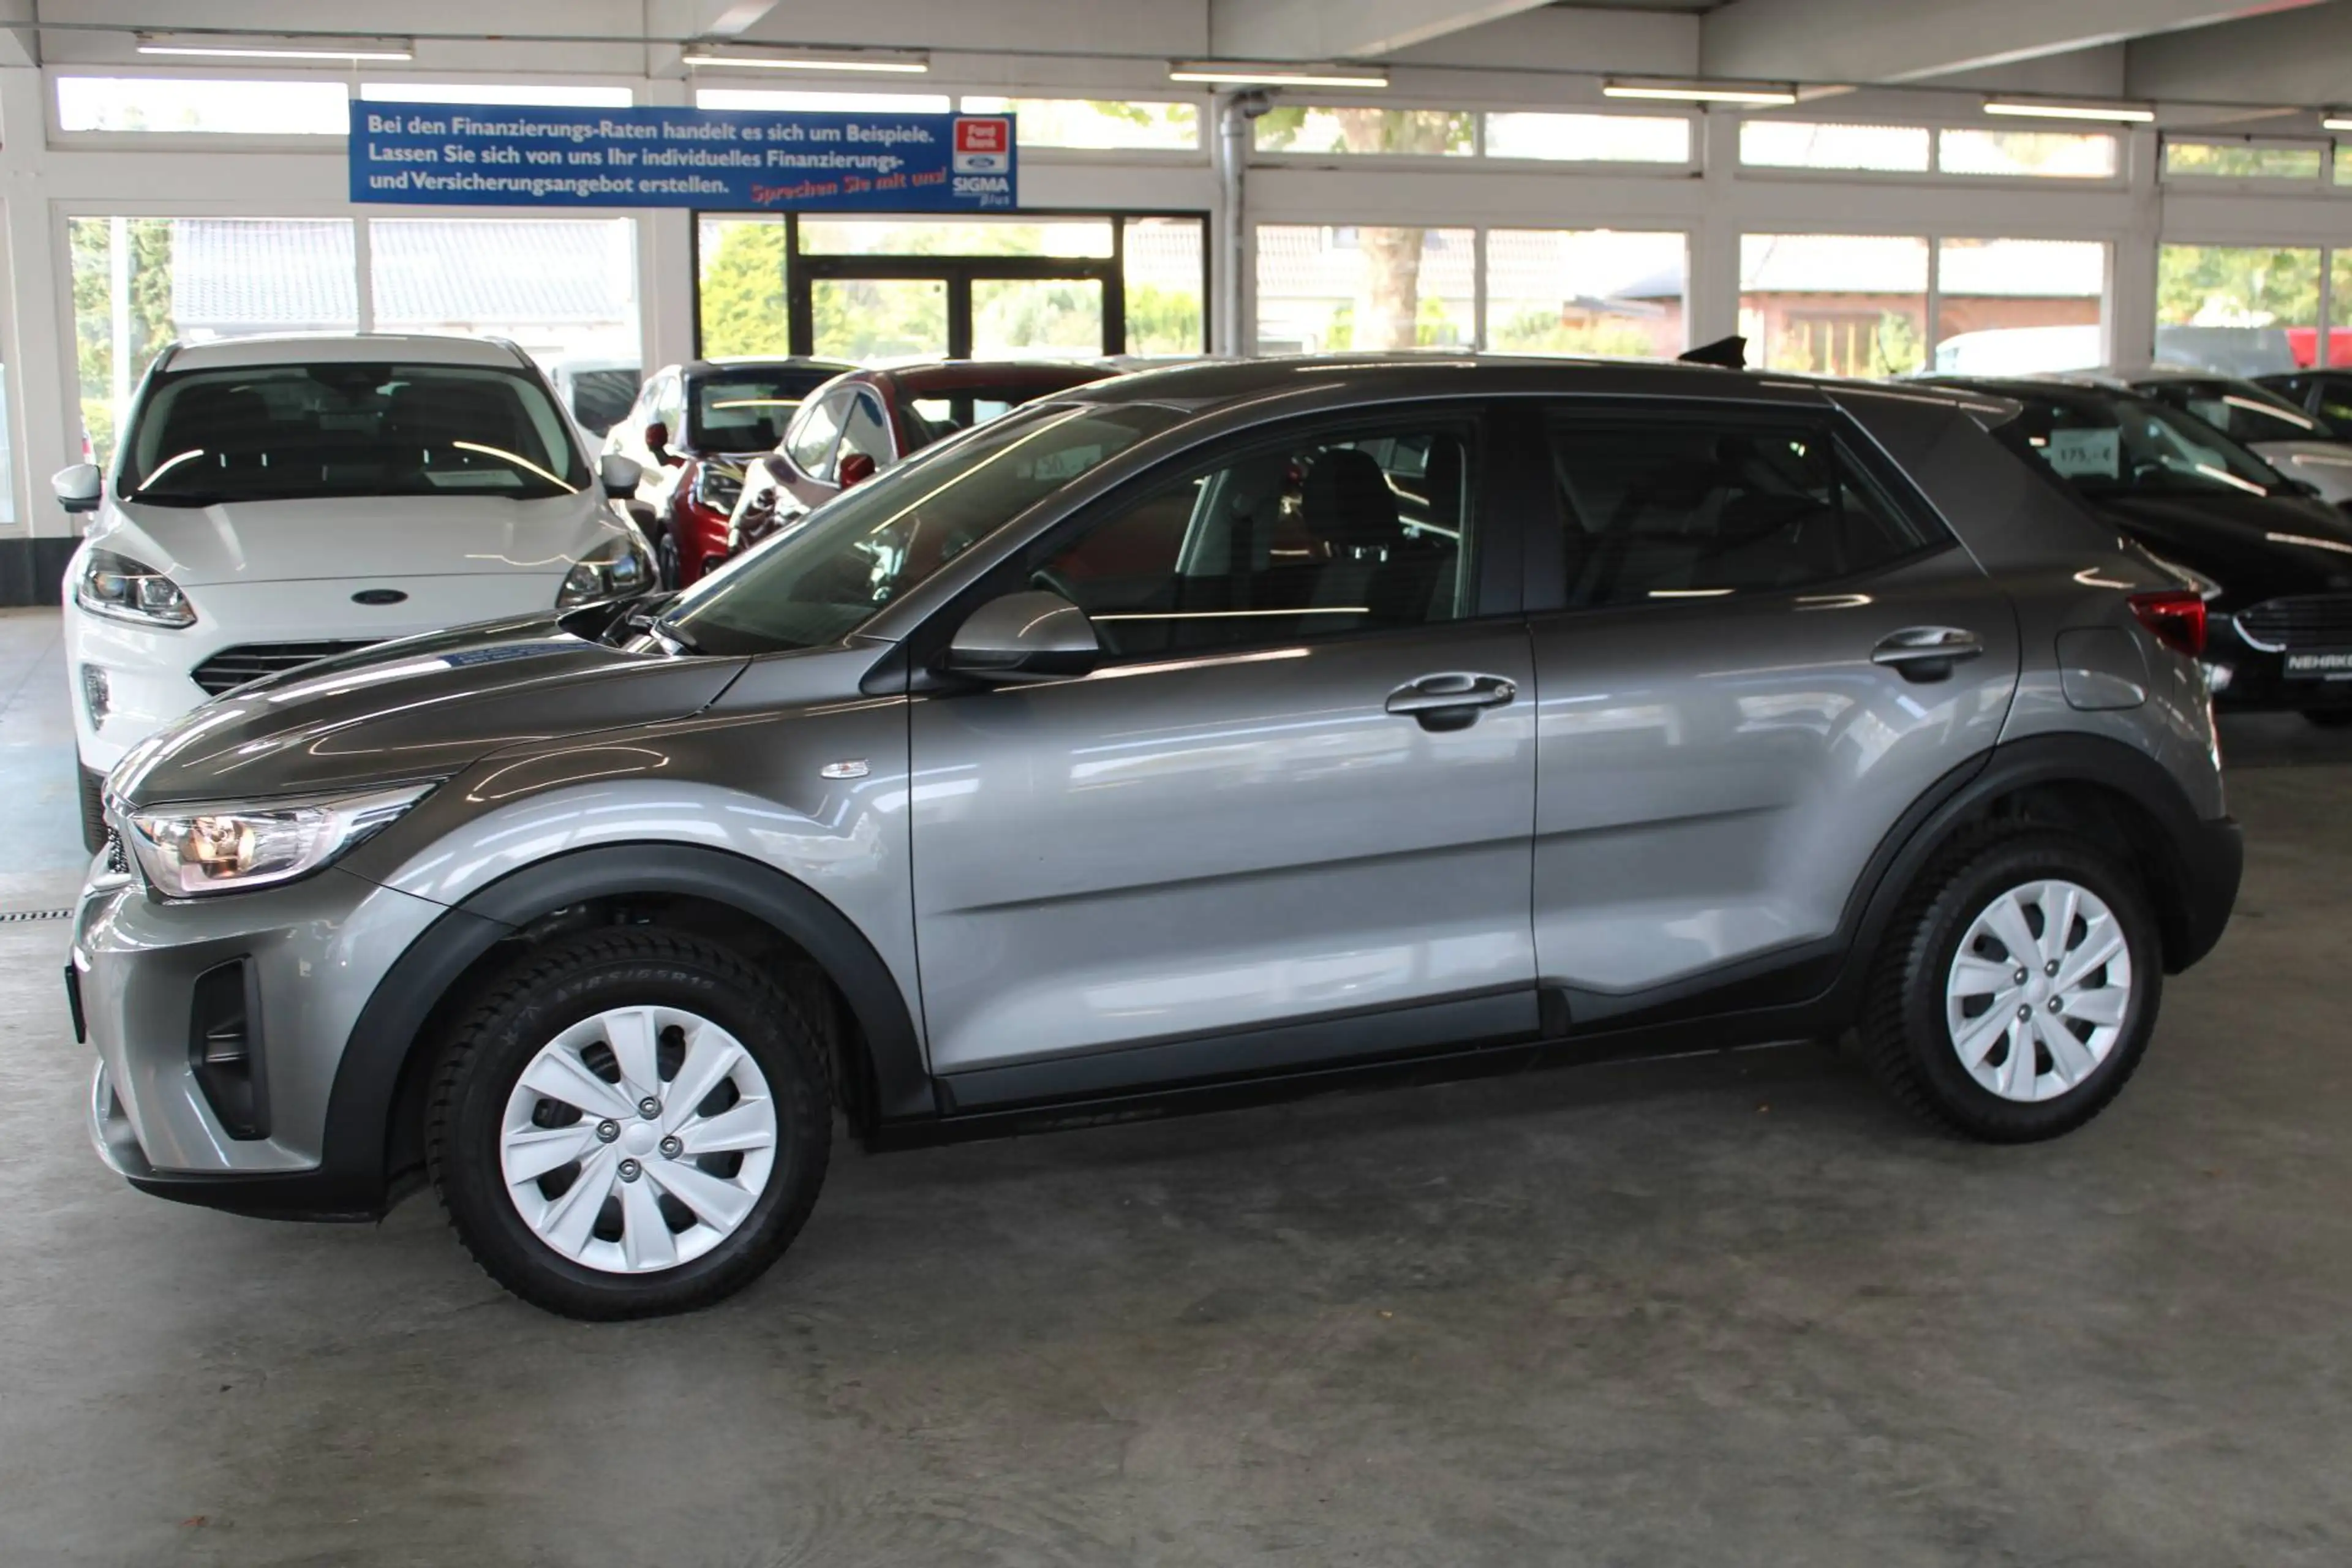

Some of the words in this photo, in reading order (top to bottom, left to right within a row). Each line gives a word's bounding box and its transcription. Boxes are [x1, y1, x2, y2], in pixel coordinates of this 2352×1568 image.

[368, 115, 401, 134] Bei
[407, 116, 445, 135] den
[452, 117, 657, 143] Finanzierungs-Raten
[662, 122, 736, 140] handelt
[742, 129, 763, 141] es
[767, 124, 804, 141] sich
[810, 130, 840, 142] um
[846, 124, 935, 146] Beispiele.
[369, 143, 437, 162] Lassen
[443, 145, 475, 163] Sie
[481, 145, 519, 164] sich
[526, 149, 562, 164] von
[568, 150, 601, 165] uns
[608, 146, 638, 165] Ihr
[643, 146, 761, 167] individuelles
[767, 151, 904, 173] Finanzierungs-
[369, 172, 408, 189] und
[411, 172, 635, 197] Versicherungsangebot
[639, 175, 729, 194] erstellen.
[750, 179, 838, 206] Sprechen
[843, 175, 870, 194] Sie
[952, 176, 1009, 193] SIGMA
